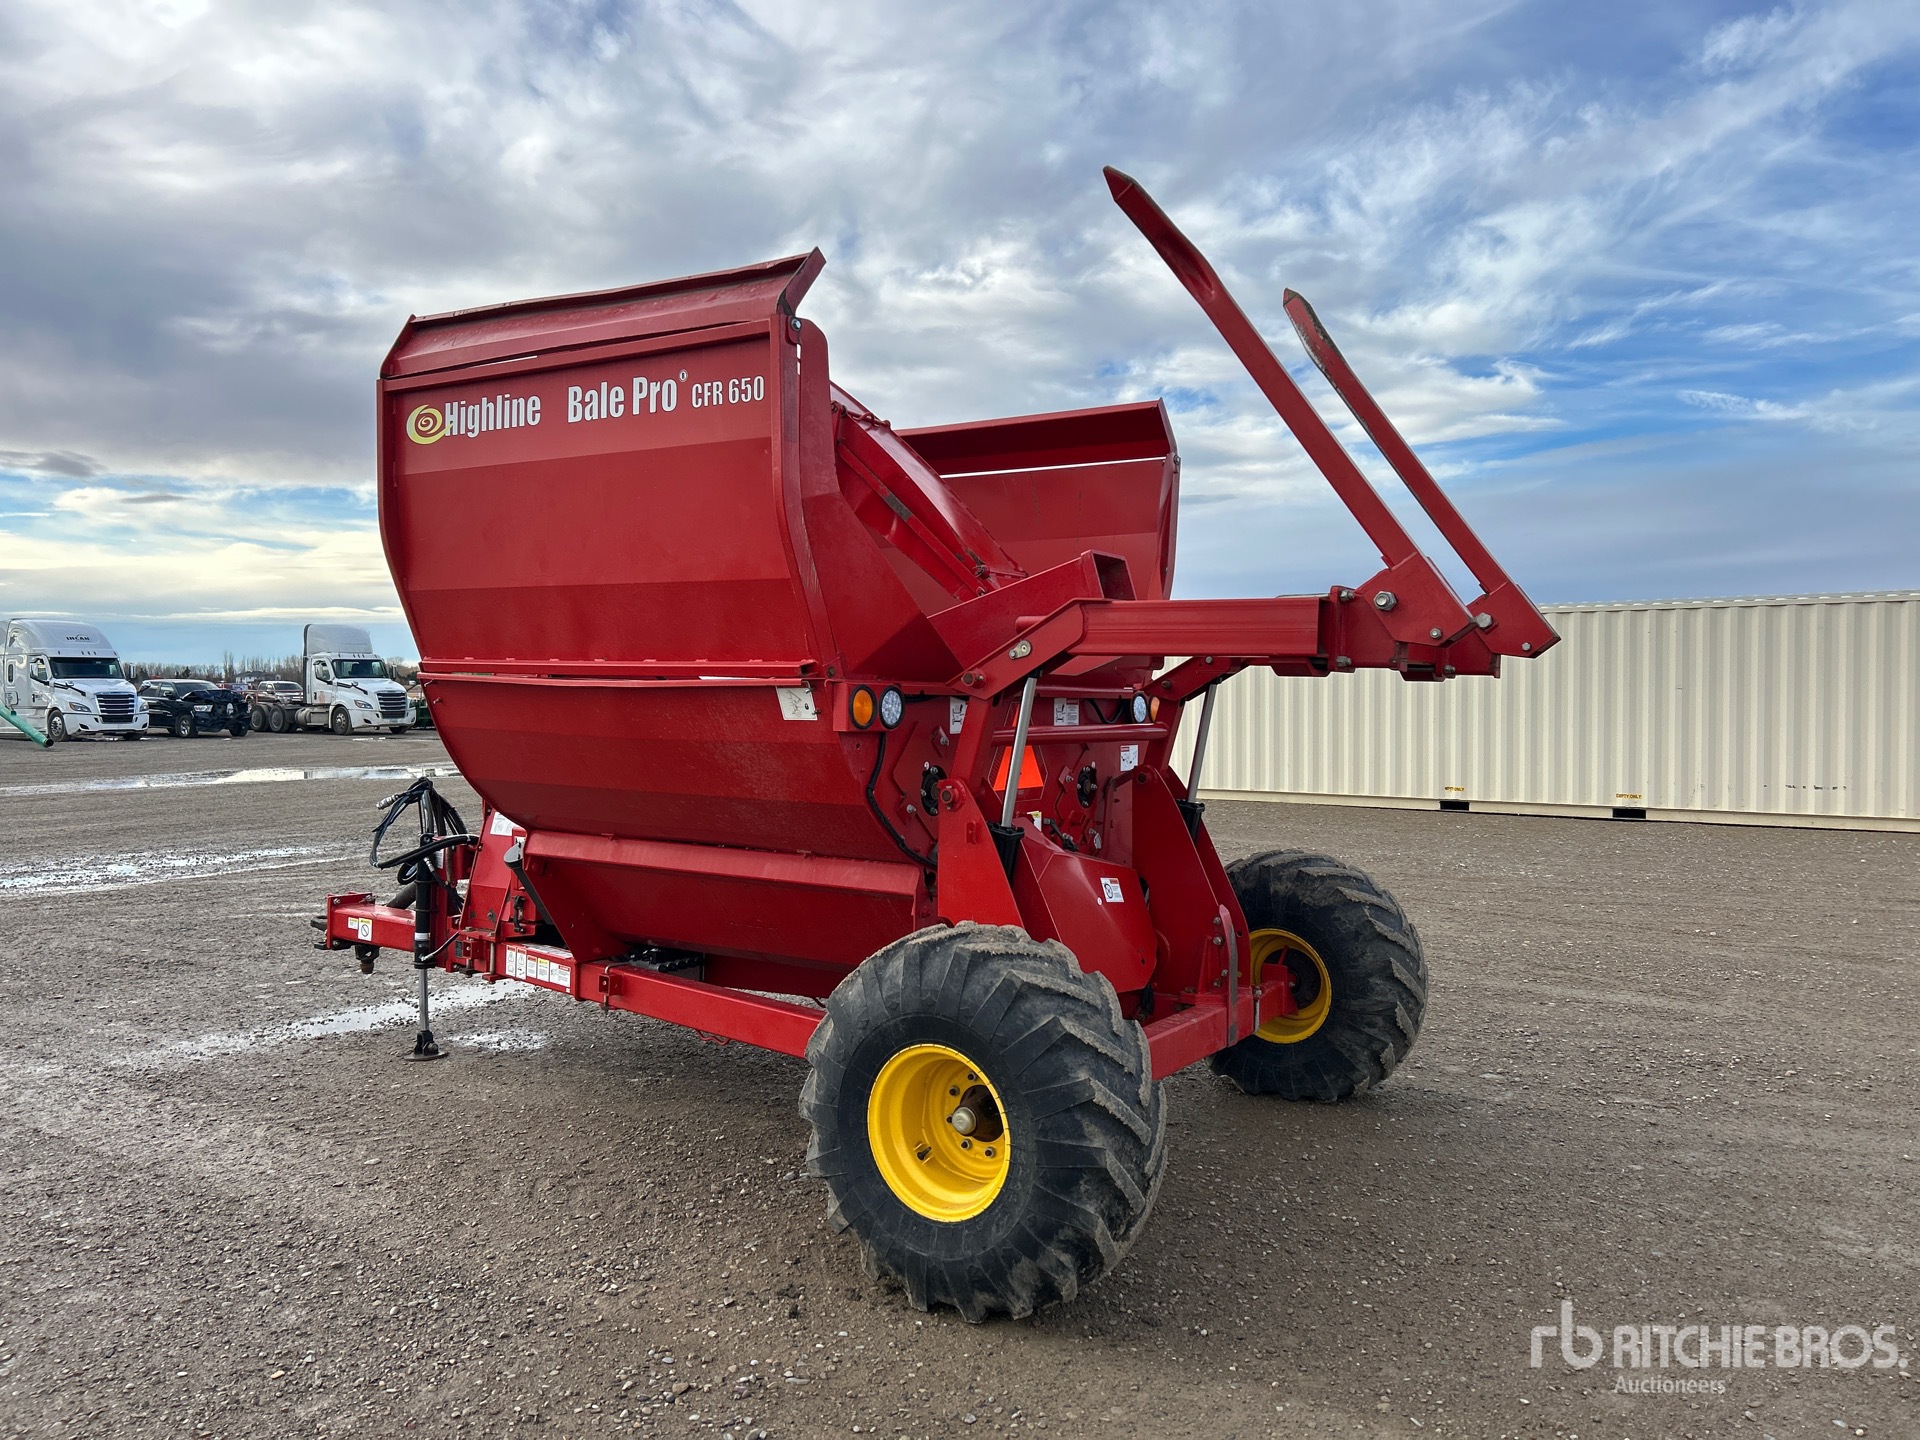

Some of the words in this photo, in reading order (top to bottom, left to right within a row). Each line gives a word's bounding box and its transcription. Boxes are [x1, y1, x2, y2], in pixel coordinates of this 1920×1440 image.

[444, 393, 541, 438] Highline
[567, 381, 625, 423] Bale
[691, 381, 723, 409] CFR
[728, 375, 765, 404] 650
